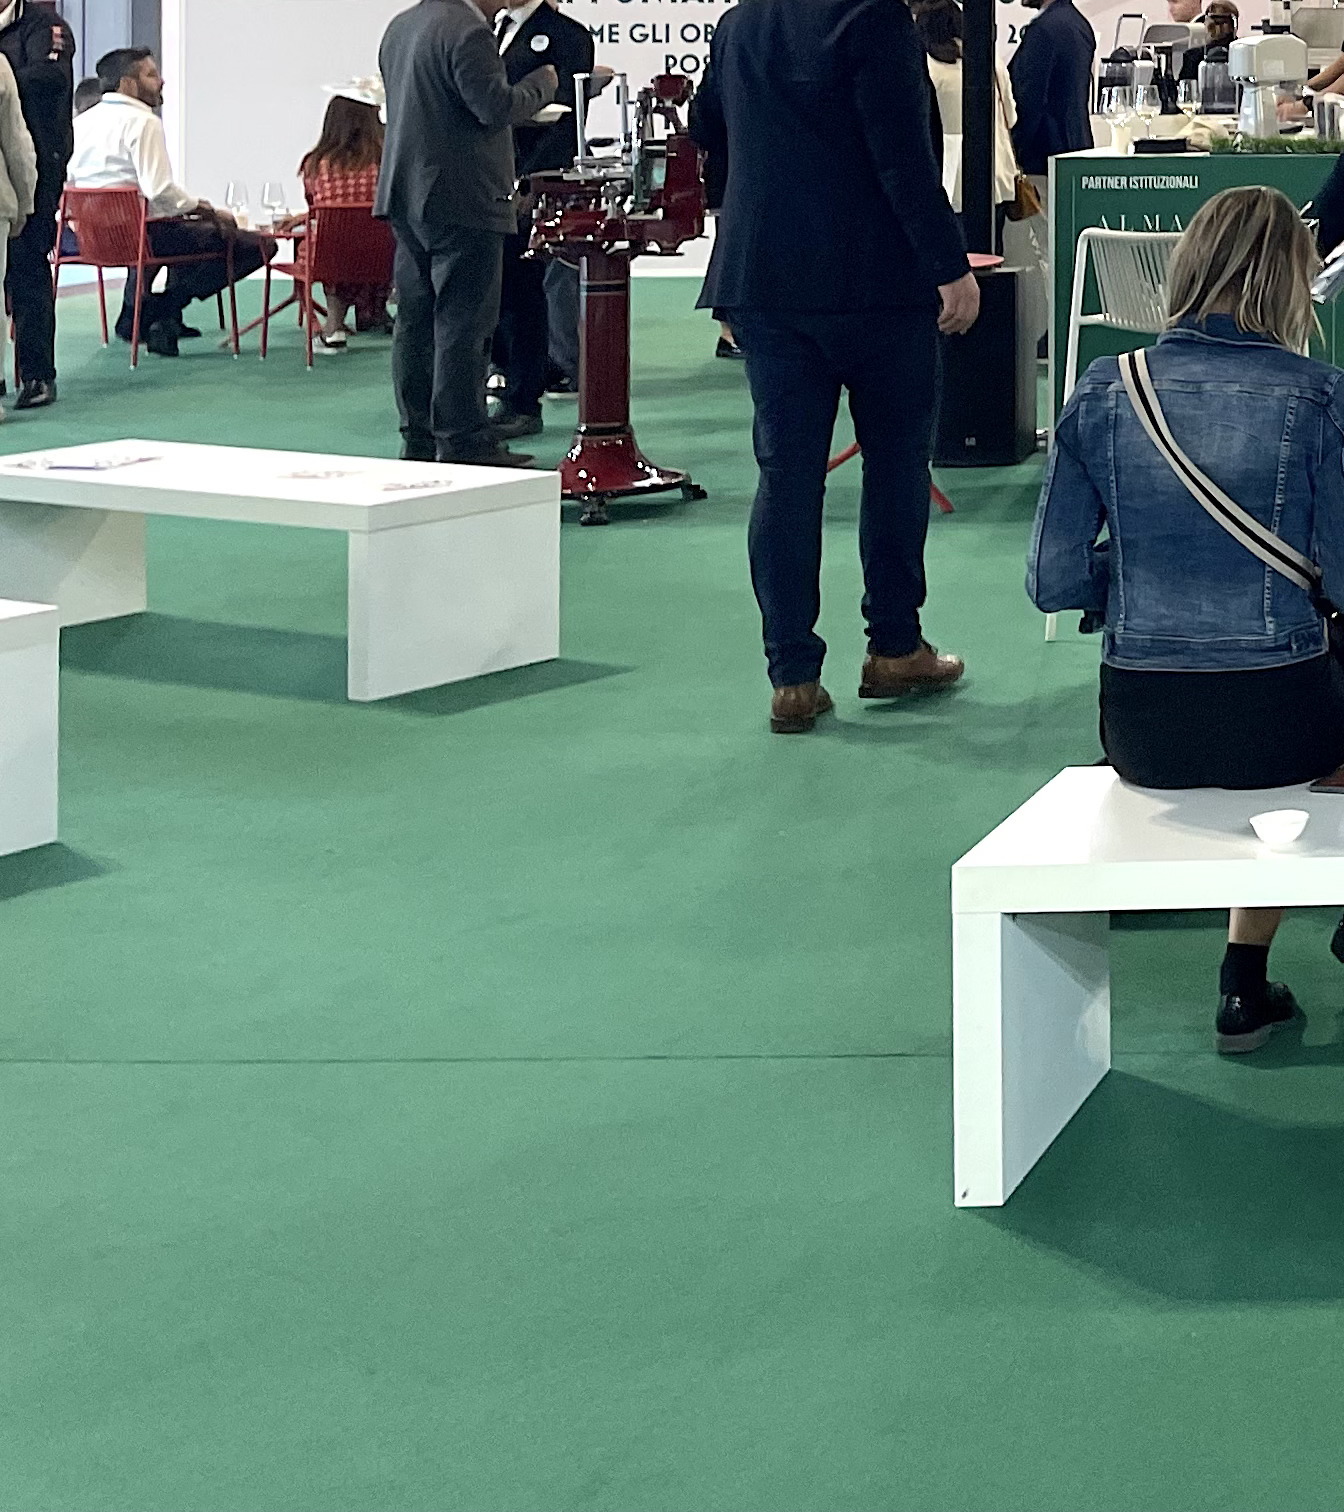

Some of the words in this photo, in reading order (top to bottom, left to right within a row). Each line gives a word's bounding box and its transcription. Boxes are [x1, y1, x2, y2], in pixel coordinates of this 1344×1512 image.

[629, 22, 670, 44] GLI
[1081, 175, 1128, 189] PARTNER
[1129, 175, 1199, 189] ISTITUZIONALI
